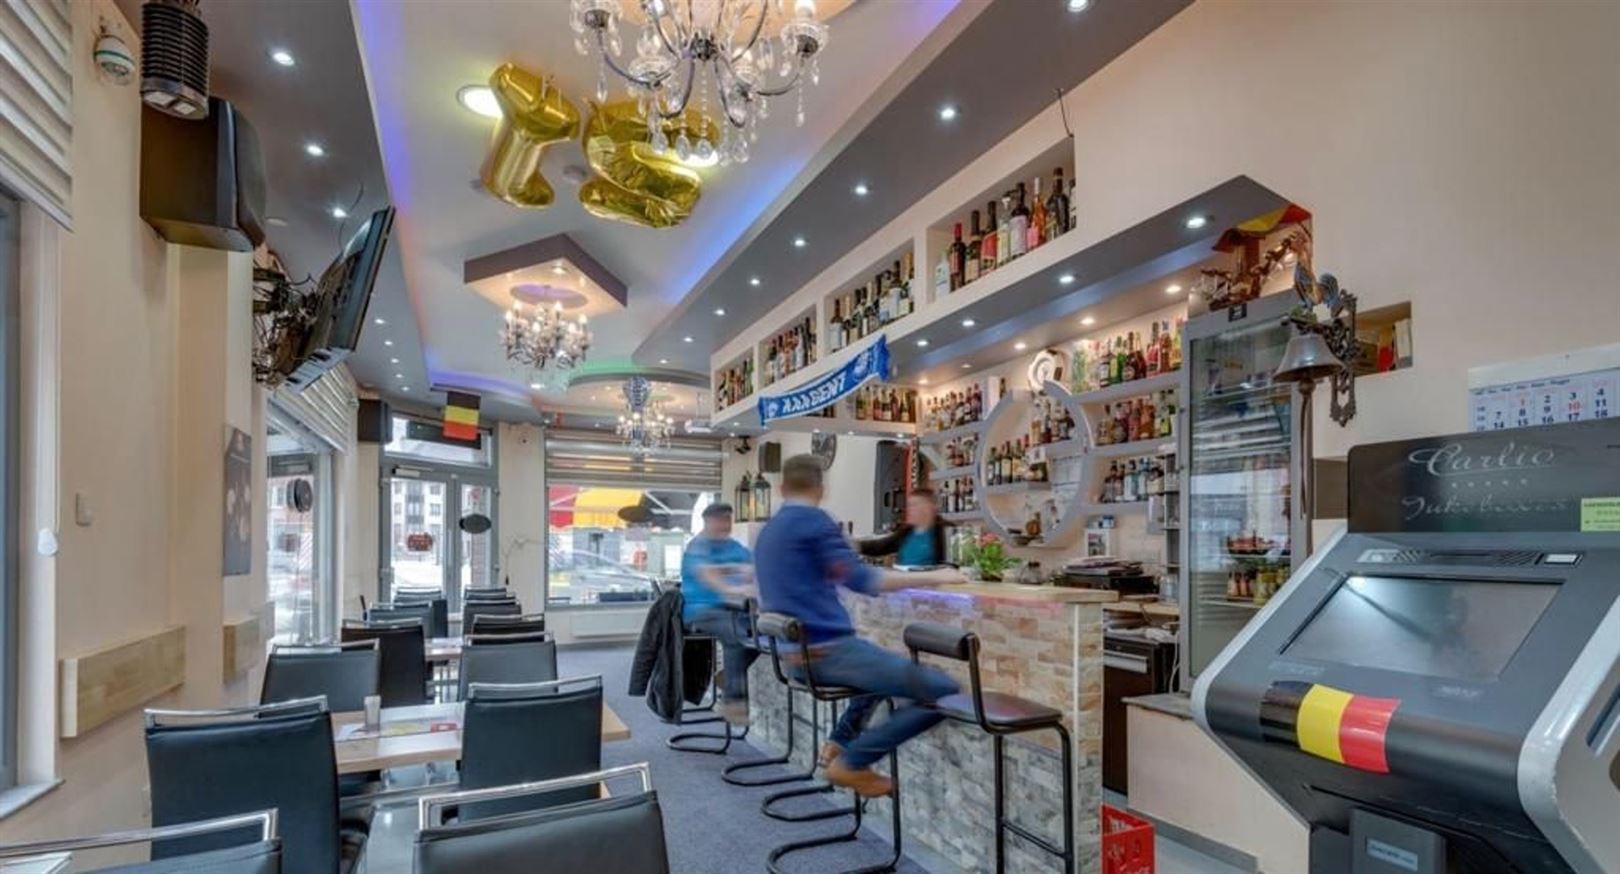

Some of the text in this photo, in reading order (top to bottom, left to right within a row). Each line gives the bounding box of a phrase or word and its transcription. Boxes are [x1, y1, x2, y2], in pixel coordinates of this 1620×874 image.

[1568, 402, 1581, 411] 10
[1595, 398, 1606, 407] 11
[1517, 418, 1529, 427] 15
[1542, 415, 1554, 424] 16
[1568, 412, 1580, 421] 17
